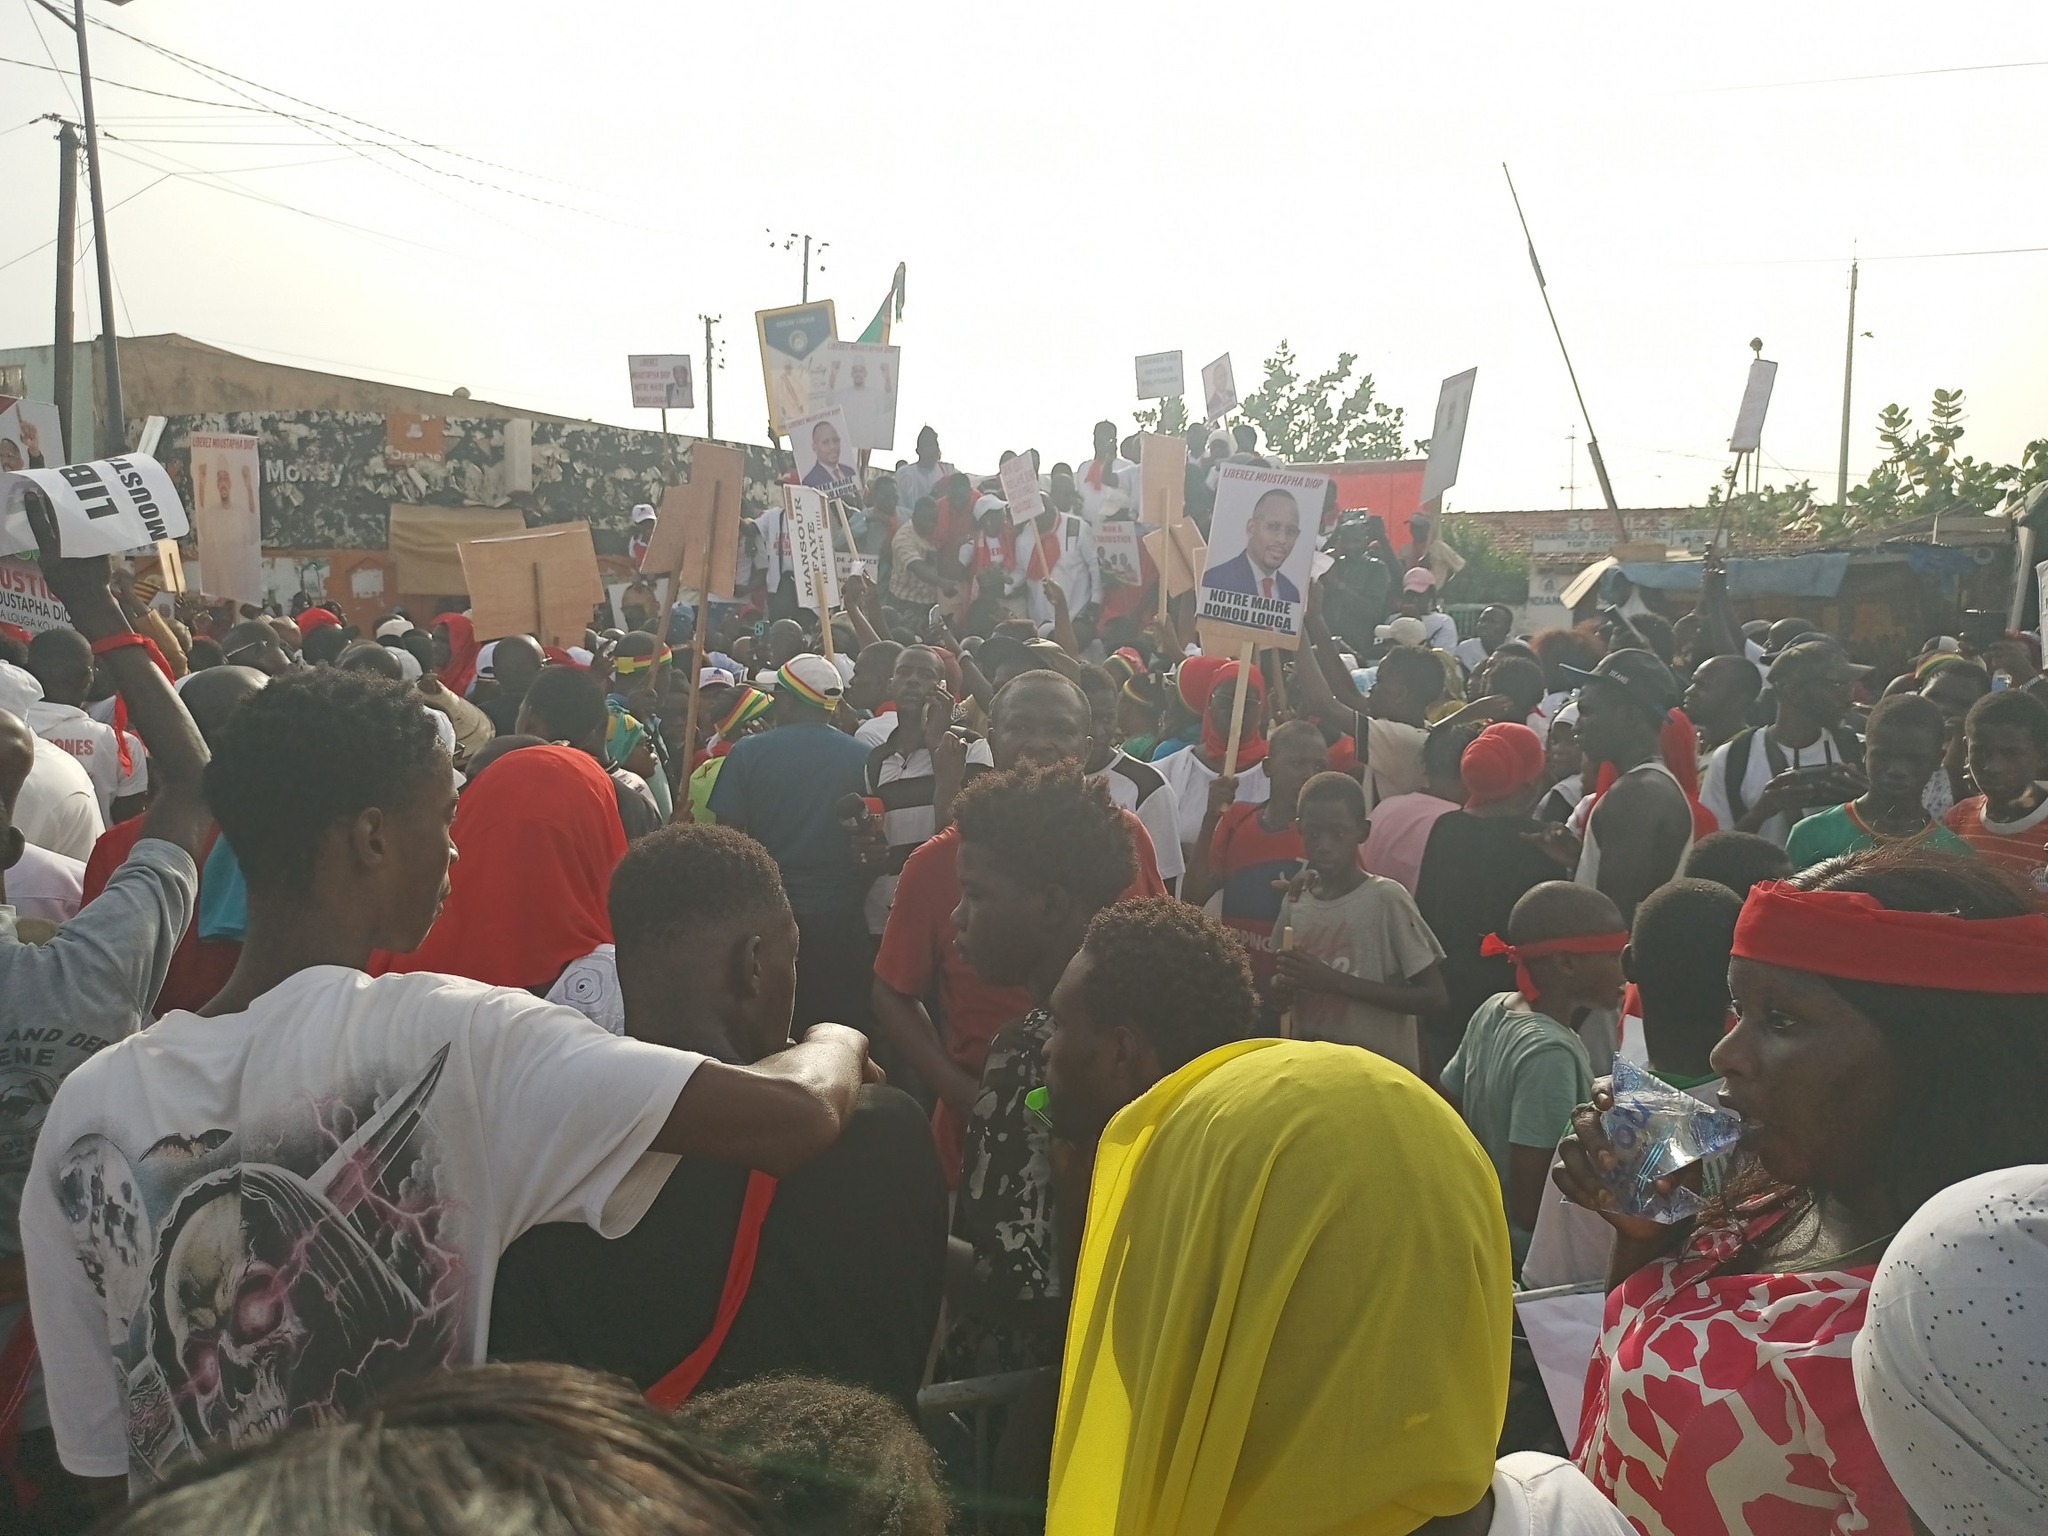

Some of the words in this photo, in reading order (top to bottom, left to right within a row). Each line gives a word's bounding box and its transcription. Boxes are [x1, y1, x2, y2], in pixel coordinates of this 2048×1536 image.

[193, 437, 212, 448] LIBEREZ
[390, 448, 442, 462] Orane
[1223, 467, 1254, 480] LIBEREZ
[1255, 472, 1304, 487] MOUSTAPHA
[1304, 478, 1323, 489] DIOP
[794, 497, 813, 597] MANSOUR
[807, 521, 820, 572] FAYE
[1209, 588, 1251, 608] NOTRE
[1251, 595, 1292, 615] MAIRE
[1203, 602, 1250, 621] DOMOU
[1250, 612, 1292, 630] LOUGA
[52, 738, 94, 756] ONES
[4, 1028, 64, 1043] AND
